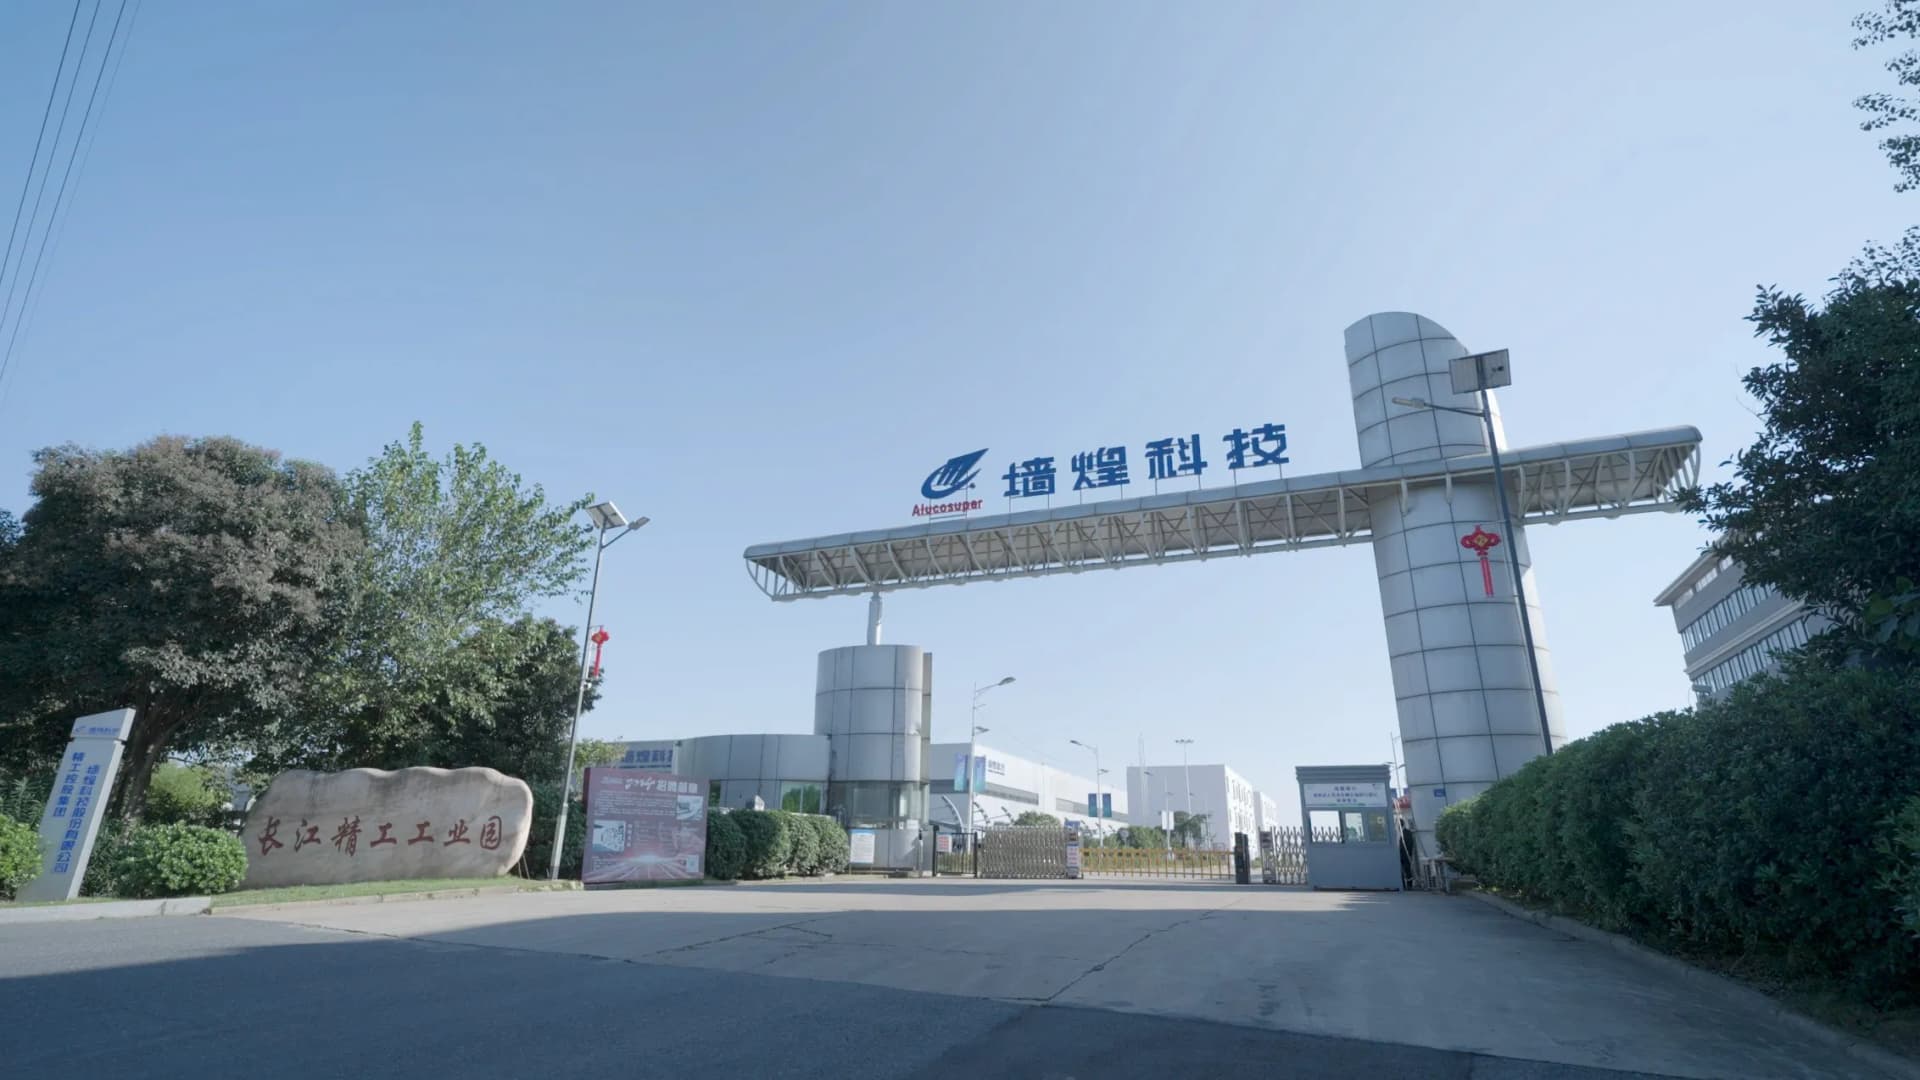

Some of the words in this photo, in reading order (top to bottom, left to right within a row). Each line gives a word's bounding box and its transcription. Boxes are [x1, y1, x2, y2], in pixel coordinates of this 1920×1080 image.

[1002, 423, 1290, 498] 墙煌科技
[912, 499, 983, 517] Alucosuper
[53, 751, 86, 818] 精工控股集团
[257, 815, 503, 857] 长江精工工业园
